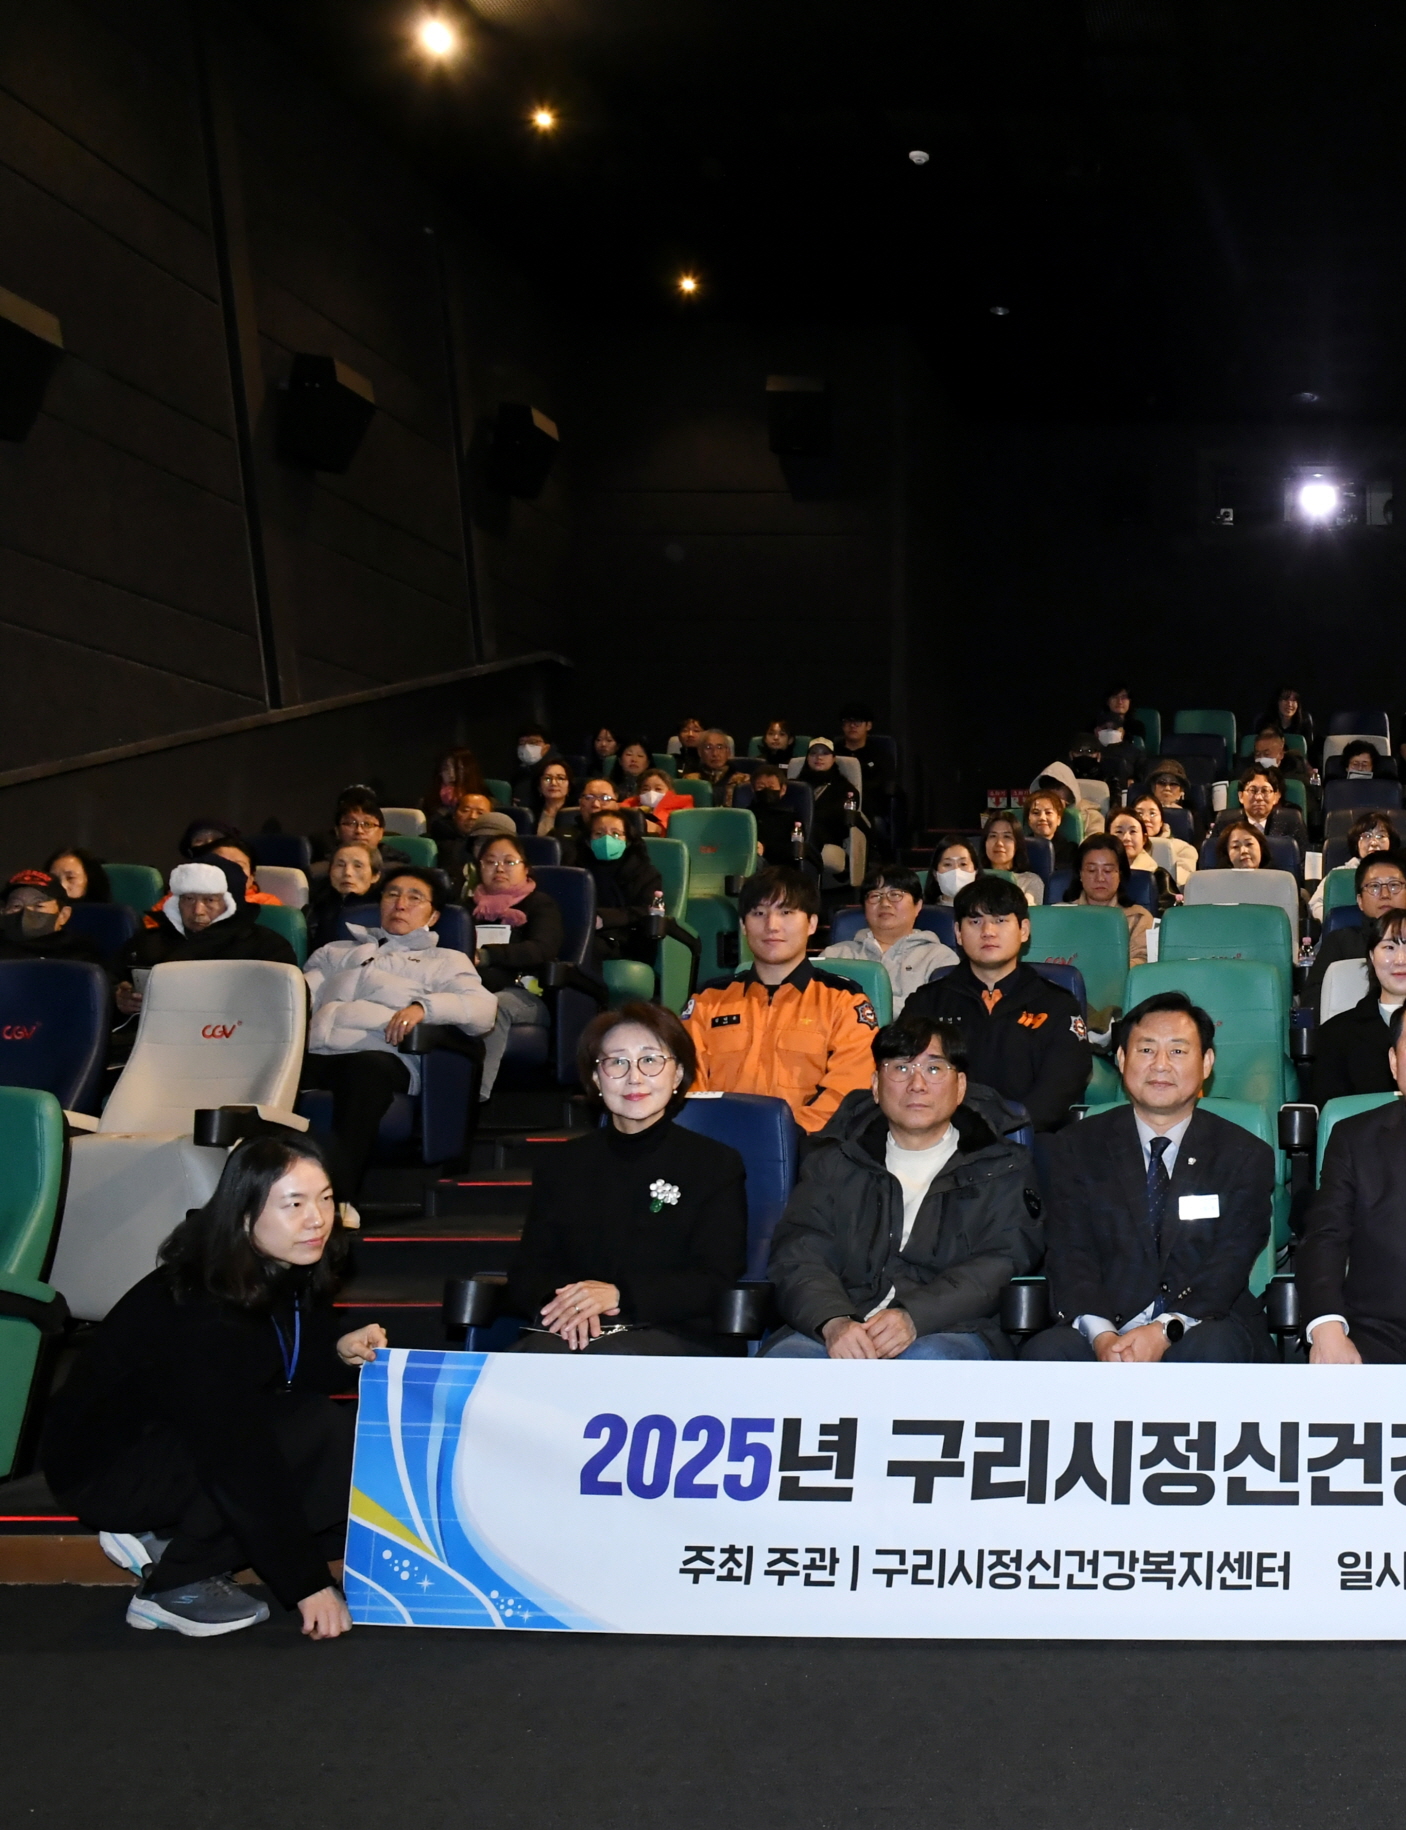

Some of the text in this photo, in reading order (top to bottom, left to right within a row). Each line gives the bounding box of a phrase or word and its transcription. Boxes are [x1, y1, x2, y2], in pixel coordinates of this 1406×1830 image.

[2, 1025, 36, 1040] CGV
[201, 1024, 236, 1039] CGV
[579, 1413, 858, 1502] 2025년
[678, 1544, 754, 1586] 주최
[763, 1547, 840, 1587] 주관
[872, 1548, 1291, 1591] 구리시정신건강복지센터
